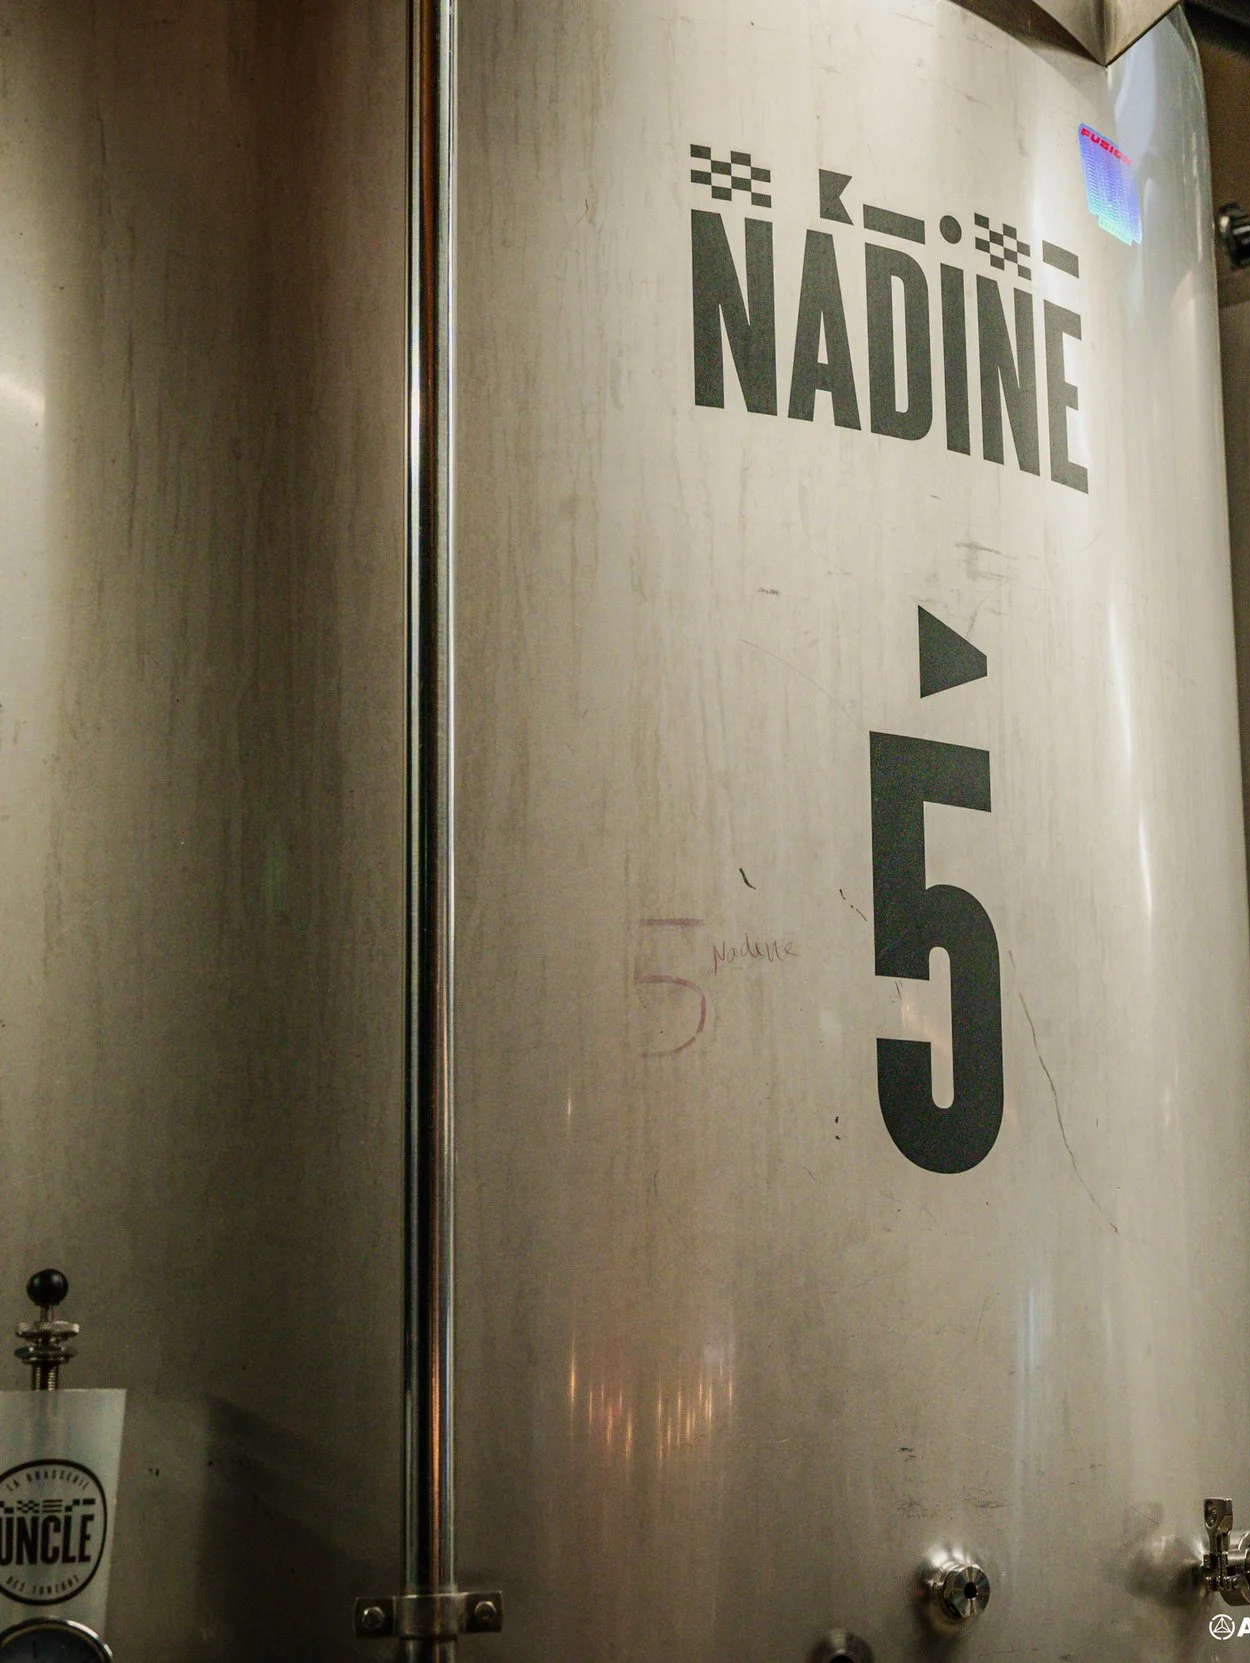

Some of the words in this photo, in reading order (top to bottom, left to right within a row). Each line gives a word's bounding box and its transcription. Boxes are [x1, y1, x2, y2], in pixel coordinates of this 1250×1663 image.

[1080, 127, 1132, 167] FUSION
[692, 209, 1089, 494] NADINE
[869, 730, 1004, 1174] 5
